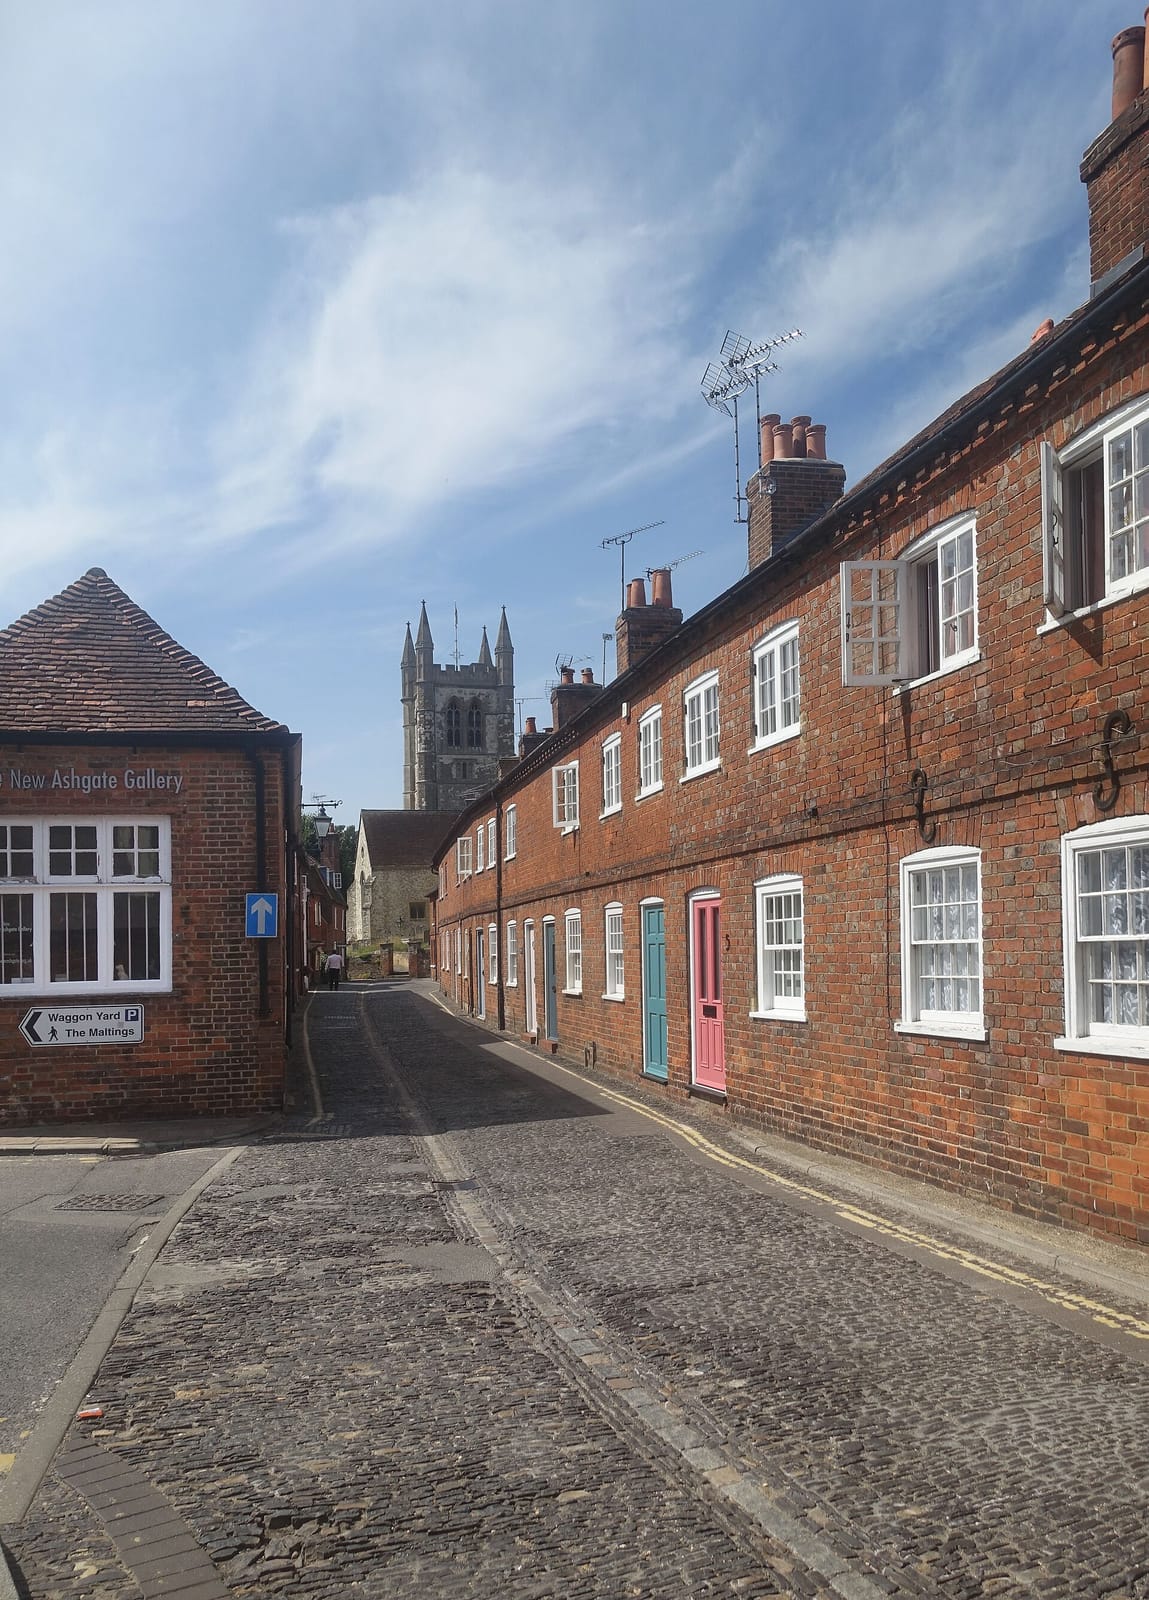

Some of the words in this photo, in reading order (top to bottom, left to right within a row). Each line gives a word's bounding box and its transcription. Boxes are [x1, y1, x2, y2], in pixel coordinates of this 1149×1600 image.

[10, 769, 45, 789] New
[52, 767, 118, 793] Ashgate
[124, 768, 183, 793] Gallery
[48, 1013, 93, 1023] Waggon
[96, 1011, 121, 1021] Yard
[127, 1010, 137, 1021] P
[65, 1029, 86, 1037] The
[89, 1027, 135, 1038] Maltings
